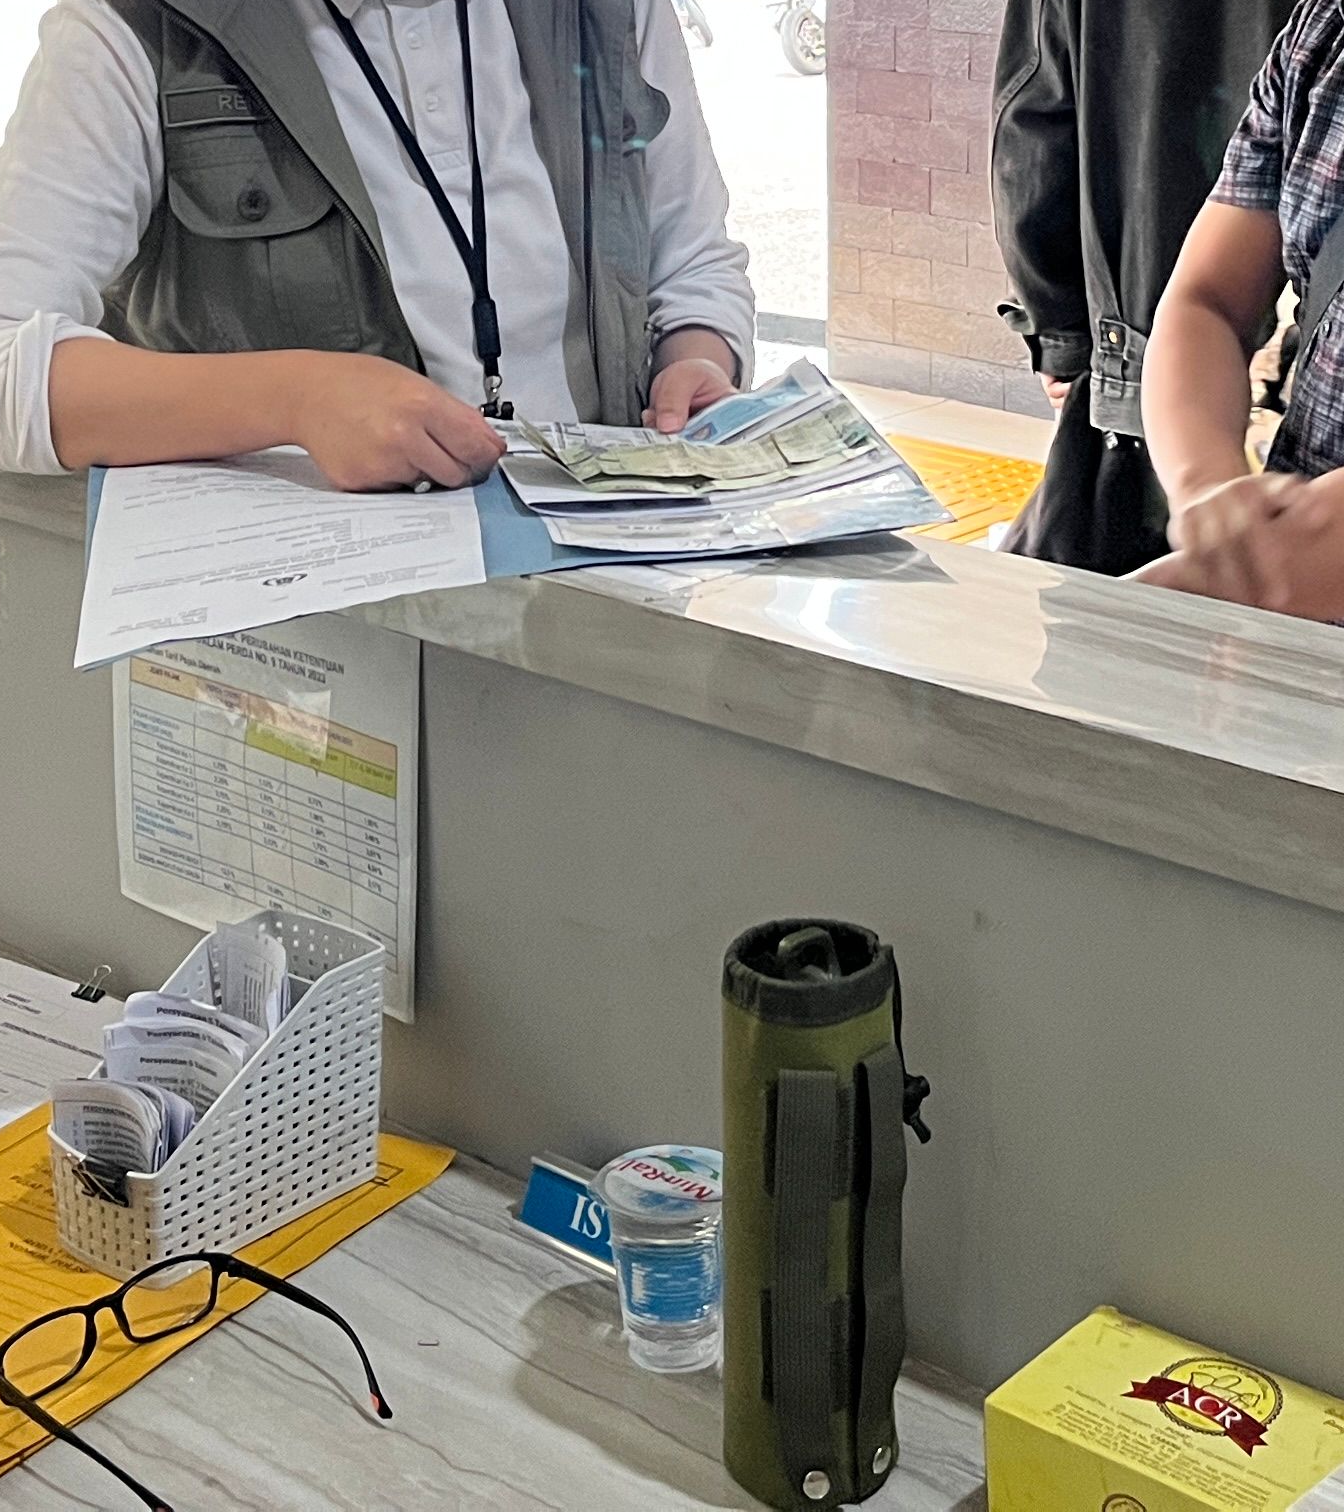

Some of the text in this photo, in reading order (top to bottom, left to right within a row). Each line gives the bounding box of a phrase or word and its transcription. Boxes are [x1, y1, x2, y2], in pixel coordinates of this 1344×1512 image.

[278, 659, 306, 677] TAHUN
[293, 650, 345, 675] KETENTUAN
[1166, 1386, 1242, 1430] ACR
